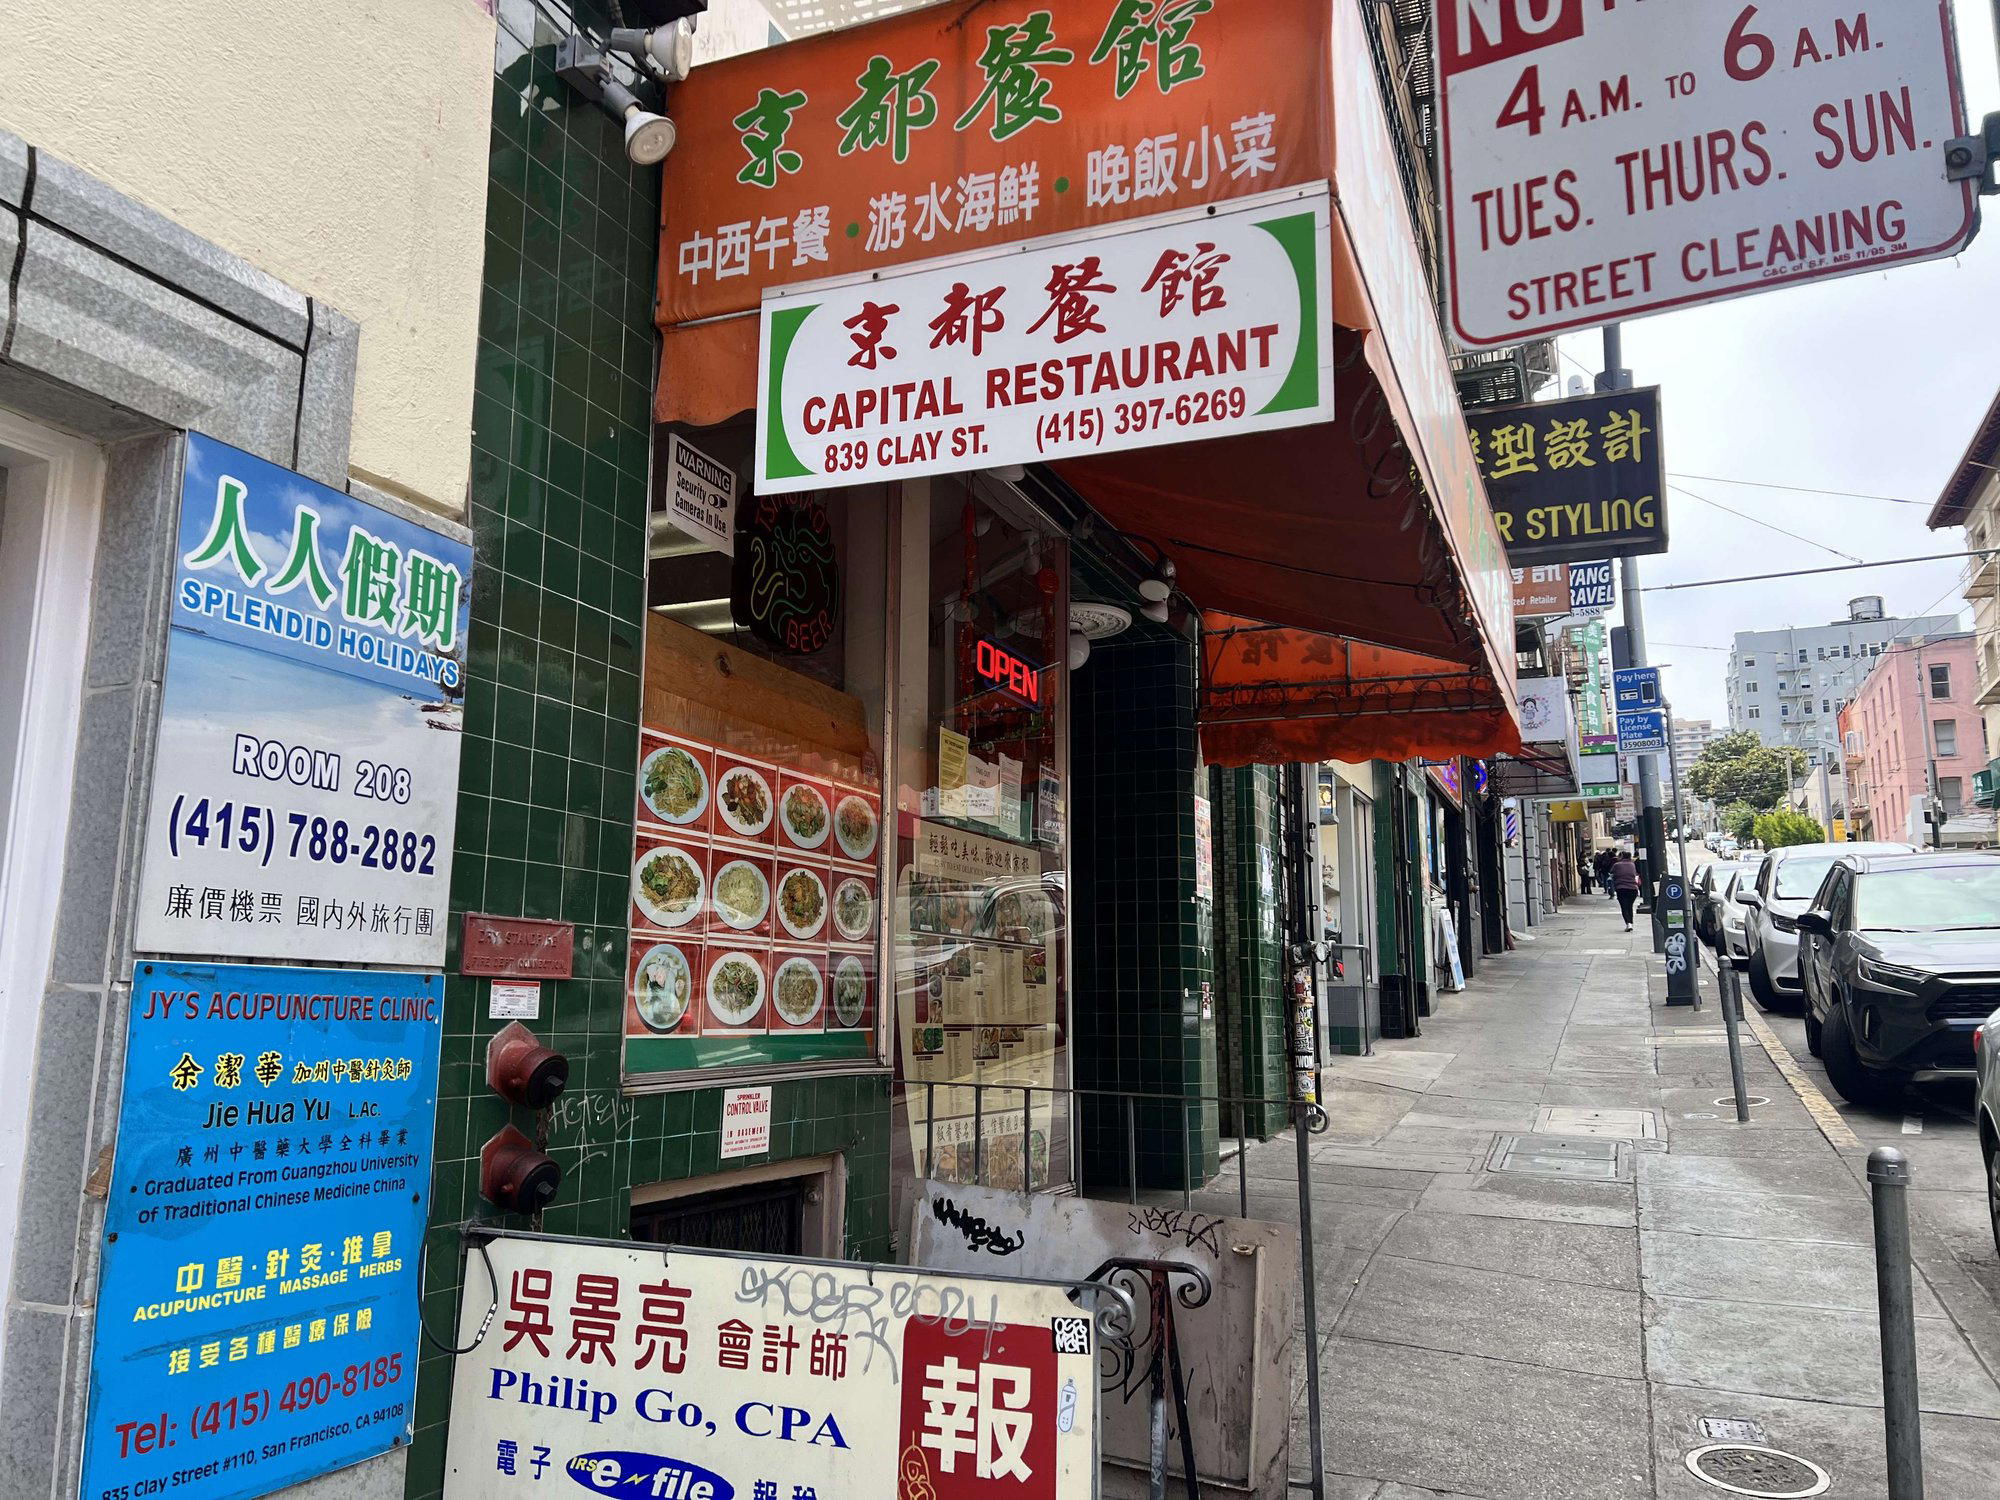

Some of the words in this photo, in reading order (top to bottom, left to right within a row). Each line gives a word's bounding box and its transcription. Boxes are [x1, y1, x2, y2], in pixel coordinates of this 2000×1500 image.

[1457, 0, 1562, 56] NO
[734, 0, 1207, 188] 京都餐館
[1496, 65, 1545, 135] 4
[1562, 74, 1642, 128] A.M.
[1666, 71, 1695, 99] TO
[1723, 4, 1775, 81] 6
[1793, 13, 1883, 68] A.M.
[1472, 170, 1594, 251] TUES.
[1615, 121, 1787, 215] THURS.
[1812, 86, 1932, 169] SUN.
[1508, 252, 1656, 320] STREET
[1681, 200, 1907, 283] CLEANING
[1891, 242, 1908, 252] 3M
[842, 242, 1231, 370] 京都餐館
[803, 376, 963, 435] CAPITAL
[986, 324, 1279, 410] RESTAURANT
[825, 440, 868, 474] 839
[876, 430, 943, 466] CLAY
[950, 424, 988, 456] ST.
[1035, 407, 1104, 453] (415)
[1114, 387, 1246, 435] 397-6269
[1470, 409, 1651, 480] 型設計
[676, 470, 707, 505] Security
[678, 444, 730, 492] WARNING
[675, 490, 705, 522] Cameras
[714, 513, 727, 534] Use
[1526, 496, 1654, 540] STYLING
[188, 479, 461, 650] 人人假期
[1529, 596, 1557, 605] Retailer
[182, 580, 332, 648] SPLENDID
[338, 626, 459, 688] HOLIDAYS
[786, 610, 832, 653] BEER
[976, 639, 1038, 702] OPEN
[1616, 675, 1633, 683] Pay
[1634, 672, 1656, 681] here
[1620, 717, 1635, 725] Pay
[1637, 715, 1649, 725] by
[1620, 723, 1652, 732] License
[1621, 731, 1643, 740] Plate
[233, 734, 340, 791] ROOM
[354, 762, 411, 804] 208
[168, 795, 275, 867] (415)
[288, 812, 436, 876] 788-2882
[164, 884, 283, 924] 廉價機票
[297, 896, 433, 936] 國內外旅行團
[143, 991, 199, 1020] JY'S
[207, 992, 373, 1021] ACUPUNCTURE
[378, 996, 435, 1021] CLINIC
[170, 1051, 283, 1091] 余潔華
[736, 1093, 761, 1101] SPRINKLER
[203, 1102, 239, 1128] Jie
[247, 1100, 295, 1125] Hua
[303, 1098, 330, 1121] Yu
[726, 1102, 752, 1116] CONTROL
[753, 1100, 768, 1113] VALVE
[138, 1206, 159, 1224] of
[164, 1196, 251, 1221] Traditional
[255, 1190, 310, 1210] Chinese
[313, 1182, 370, 1201] Medicine
[373, 1176, 406, 1196] China
[144, 1176, 234, 1197] Graduated
[238, 1169, 278, 1186] From
[281, 1159, 357, 1182] Guangzhou
[361, 1152, 420, 1172] University
[133, 1285, 267, 1322] ACUPUNCTURE
[279, 1269, 348, 1295] MASSAGE
[359, 1258, 403, 1279] HERBS
[503, 1268, 692, 1374] 吳景亮
[718, 1318, 848, 1381] 會計師
[115, 1413, 177, 1459] Tel:
[190, 1389, 270, 1440] (415)
[278, 1352, 403, 1414] 490-8185
[487, 1368, 617, 1424] Philip
[635, 1388, 717, 1438] Go,
[735, 1401, 852, 1449] CPA
[921, 1356, 1033, 1483] 報
[134, 1477, 168, 1500] Clay
[171, 1459, 219, 1487] Street
[222, 1450, 258, 1473] #110,
[261, 1441, 286, 1460] San
[289, 1423, 352, 1451] Francisco,
[355, 1414, 371, 1432] CA
[372, 1402, 404, 1425] 94108
[497, 1439, 551, 1480] 電子
[569, 1457, 598, 1473] IRS
